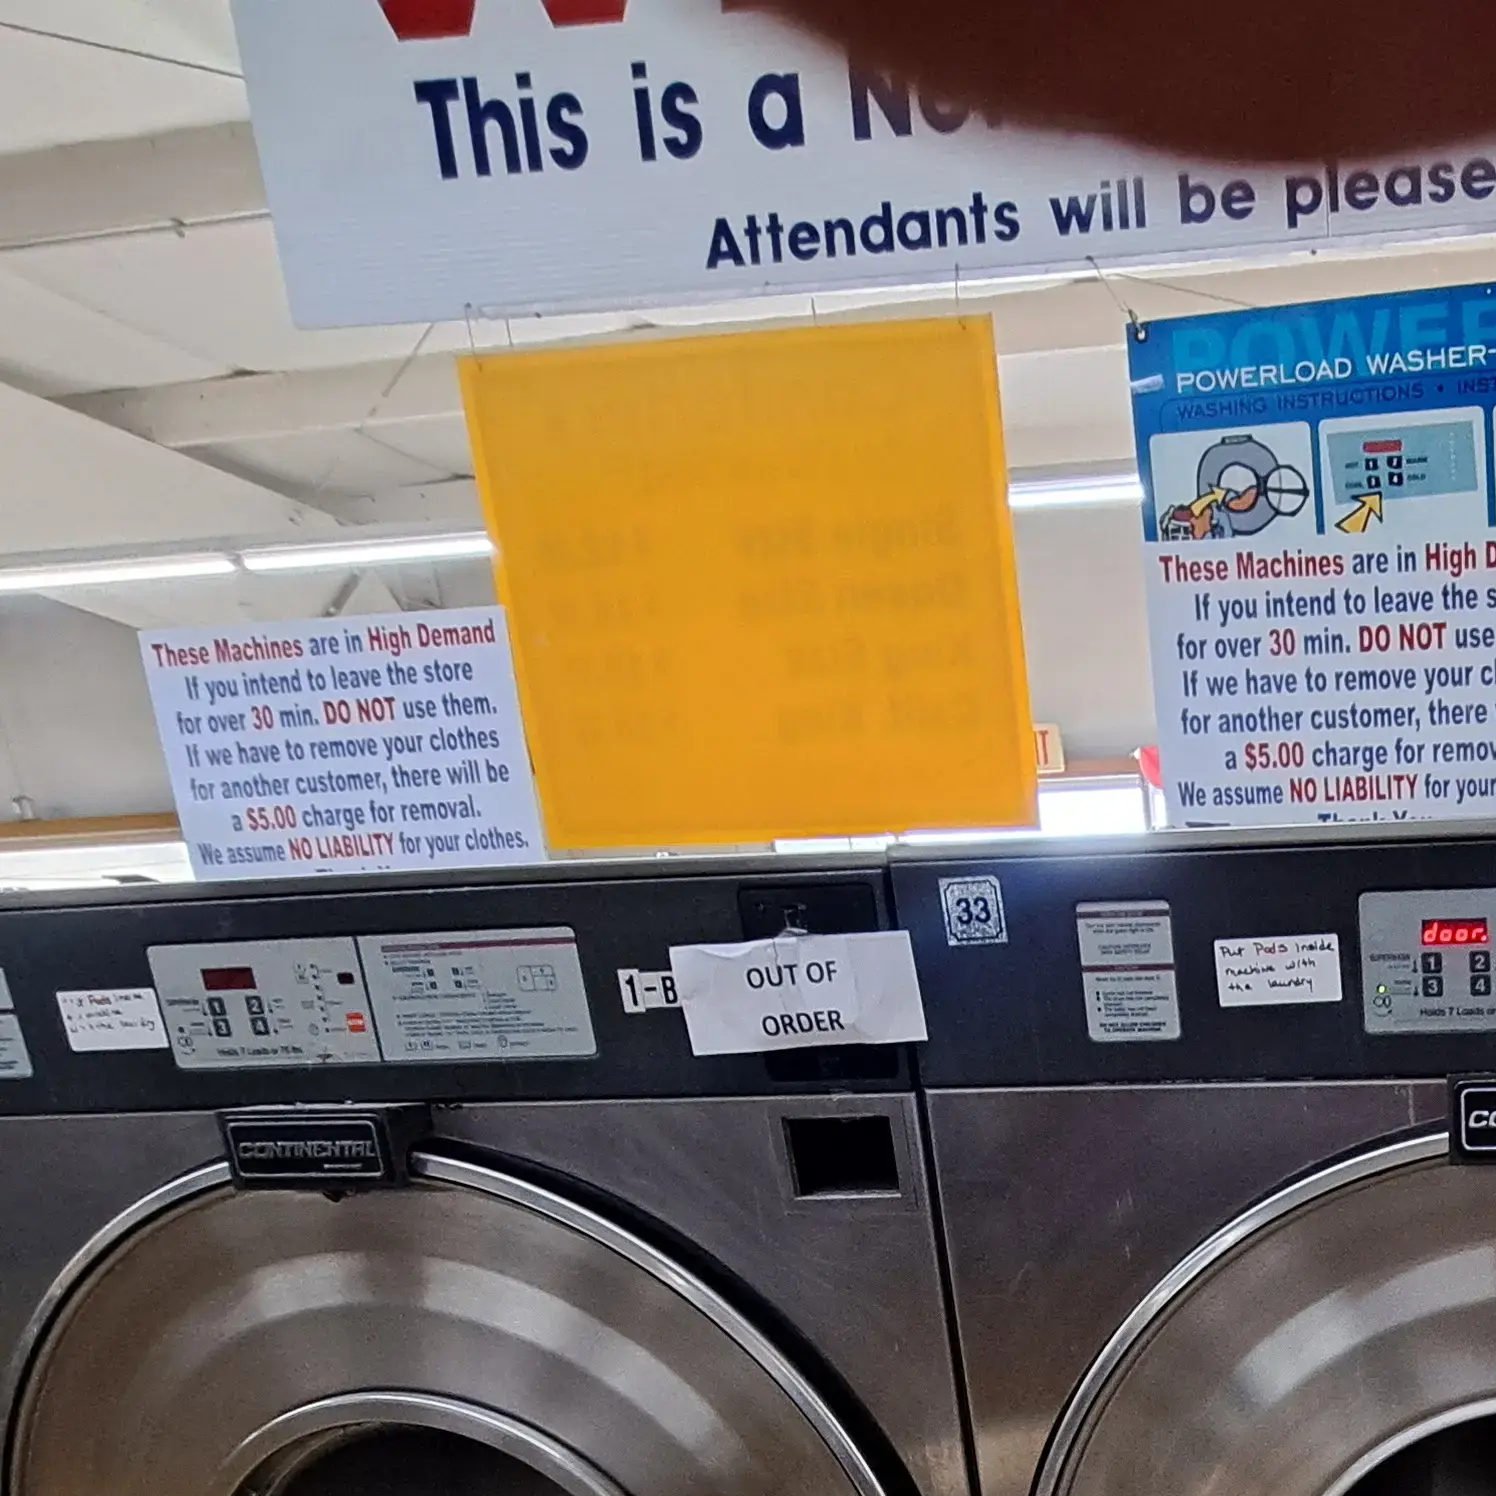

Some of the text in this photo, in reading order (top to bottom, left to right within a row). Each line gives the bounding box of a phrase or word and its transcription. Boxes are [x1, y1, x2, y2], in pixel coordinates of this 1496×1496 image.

[413, 72, 589, 180] This
[631, 62, 704, 163] is
[747, 73, 804, 148] a
[705, 191, 1020, 271] Attendants
[1049, 176, 1145, 236] will
[1178, 172, 1255, 225] be
[1177, 357, 1353, 393] POWERLOAD
[1177, 398, 1267, 419] WASHING
[1277, 382, 1423, 410] INSTRUCTIONS
[1158, 554, 1228, 583] These
[1236, 549, 1344, 580] Machines
[1352, 552, 1388, 575] are
[1397, 548, 1417, 573] in
[1425, 541, 1476, 578] High
[1194, 592, 1210, 621] If
[1217, 598, 1257, 628] you
[1265, 587, 1336, 618] intend
[1343, 587, 1366, 615] to
[1373, 585, 1434, 614] leave
[1441, 582, 1478, 610] the
[151, 620, 495, 667] These Machines are in High Demand
[1176, 632, 1207, 660] for
[1214, 636, 1262, 659] over
[1268, 627, 1295, 656] 30
[1303, 626, 1351, 655] min.
[1358, 624, 1390, 653] DO
[1398, 621, 1447, 651] NOT
[1455, 627, 1495, 649] use
[1182, 669, 1198, 697] If
[1205, 675, 1238, 696] we
[1245, 667, 1297, 695] have
[1304, 666, 1327, 693] to
[1334, 668, 1416, 691] remove
[1423, 665, 1473, 695] your
[1180, 707, 1211, 735] for
[1218, 705, 1304, 733] another
[1310, 702, 1420, 732] customer,
[1427, 697, 1488, 726] there
[1225, 750, 1237, 770] a
[1244, 741, 1304, 771] $5.00
[1312, 739, 1388, 772] charge
[1394, 737, 1425, 764] for
[1177, 781, 1206, 806] We
[1212, 785, 1283, 806] assume
[1289, 777, 1317, 803] NO
[1323, 773, 1418, 802] LIABILITY
[1424, 772, 1450, 798] for
[1455, 777, 1496, 805] your
[956, 897, 991, 925] 33
[1219, 945, 1245, 958] Put
[1253, 942, 1288, 955] Pods
[1428, 956, 1436, 969] 1
[1475, 955, 1485, 969] 2
[746, 961, 837, 989] OUT OF
[1268, 977, 1313, 993] laundry
[1428, 981, 1438, 994] 3
[1475, 979, 1485, 993] 4
[253, 999, 261, 1012] 2
[625, 975, 678, 1007] 1-B
[214, 1000, 222, 1013] 1
[219, 1021, 228, 1035] 3
[761, 1010, 845, 1037] ORDER
[238, 1140, 377, 1159] CONTINENTAL
